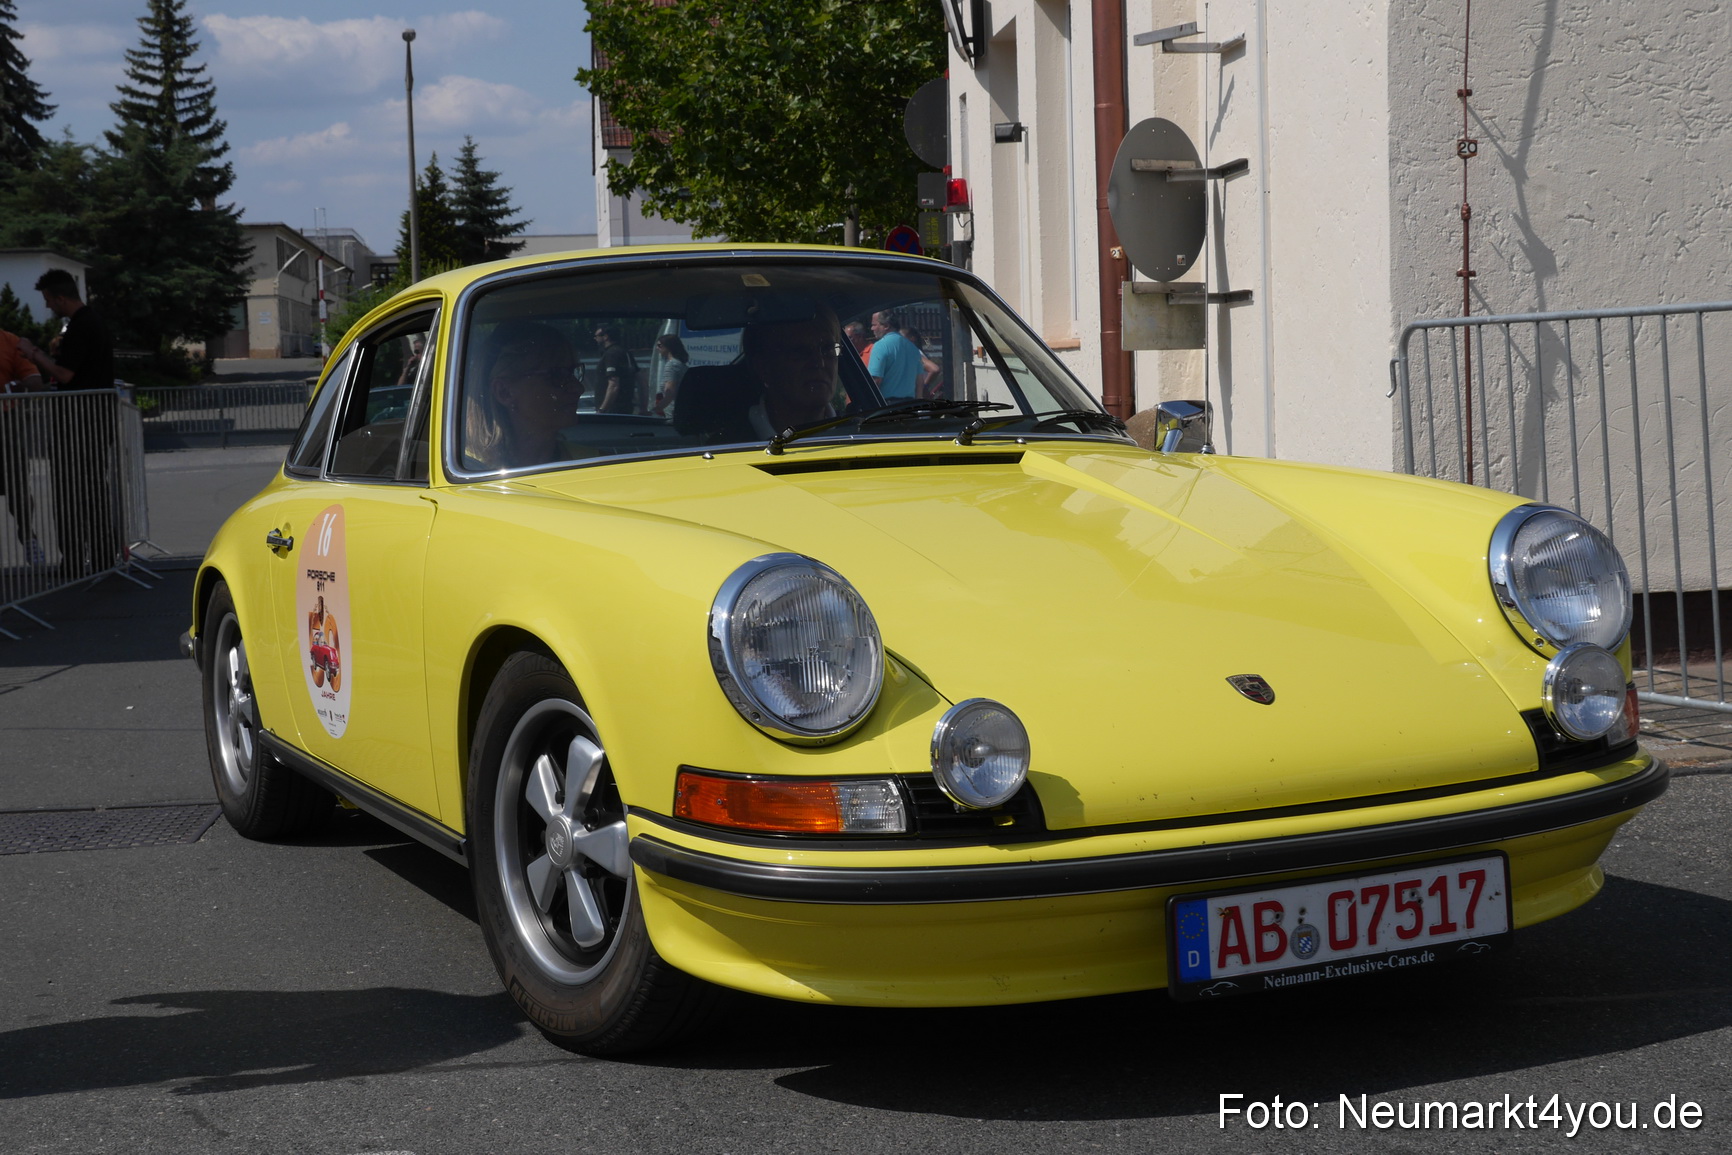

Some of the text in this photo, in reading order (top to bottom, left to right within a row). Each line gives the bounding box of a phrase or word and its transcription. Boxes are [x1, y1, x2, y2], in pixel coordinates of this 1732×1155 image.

[1458, 142, 1477, 153] 20
[317, 513, 337, 557] 16
[307, 568, 336, 582] PORSCHE
[316, 581, 325, 592] 911
[321, 688, 336, 702] JAHRE
[1217, 869, 1486, 969] AB 07517
[1188, 950, 1200, 968] D
[1263, 950, 1435, 990] Neimann-Exclusive-Cars.de
[510, 983, 577, 1031] MICHELIN
